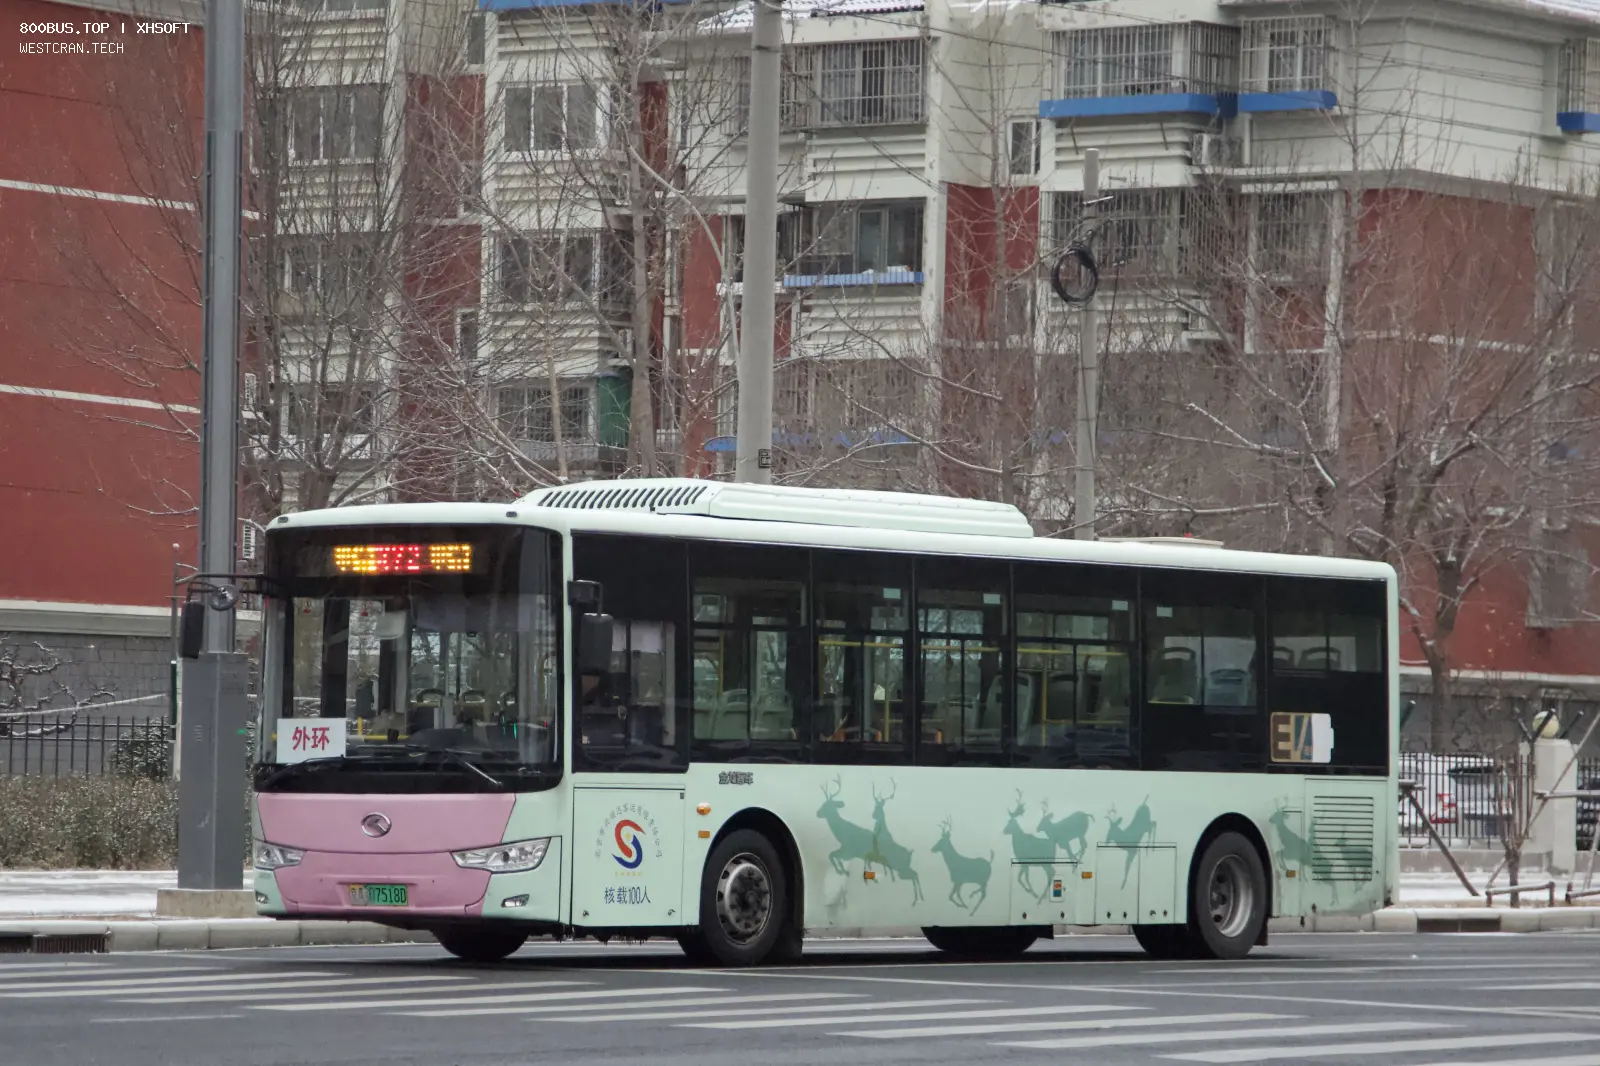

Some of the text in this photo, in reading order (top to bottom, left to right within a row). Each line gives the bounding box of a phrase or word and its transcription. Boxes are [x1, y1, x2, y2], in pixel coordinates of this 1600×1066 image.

[292, 726, 330, 751] 外环
[603, 885, 652, 905] 核载100人
